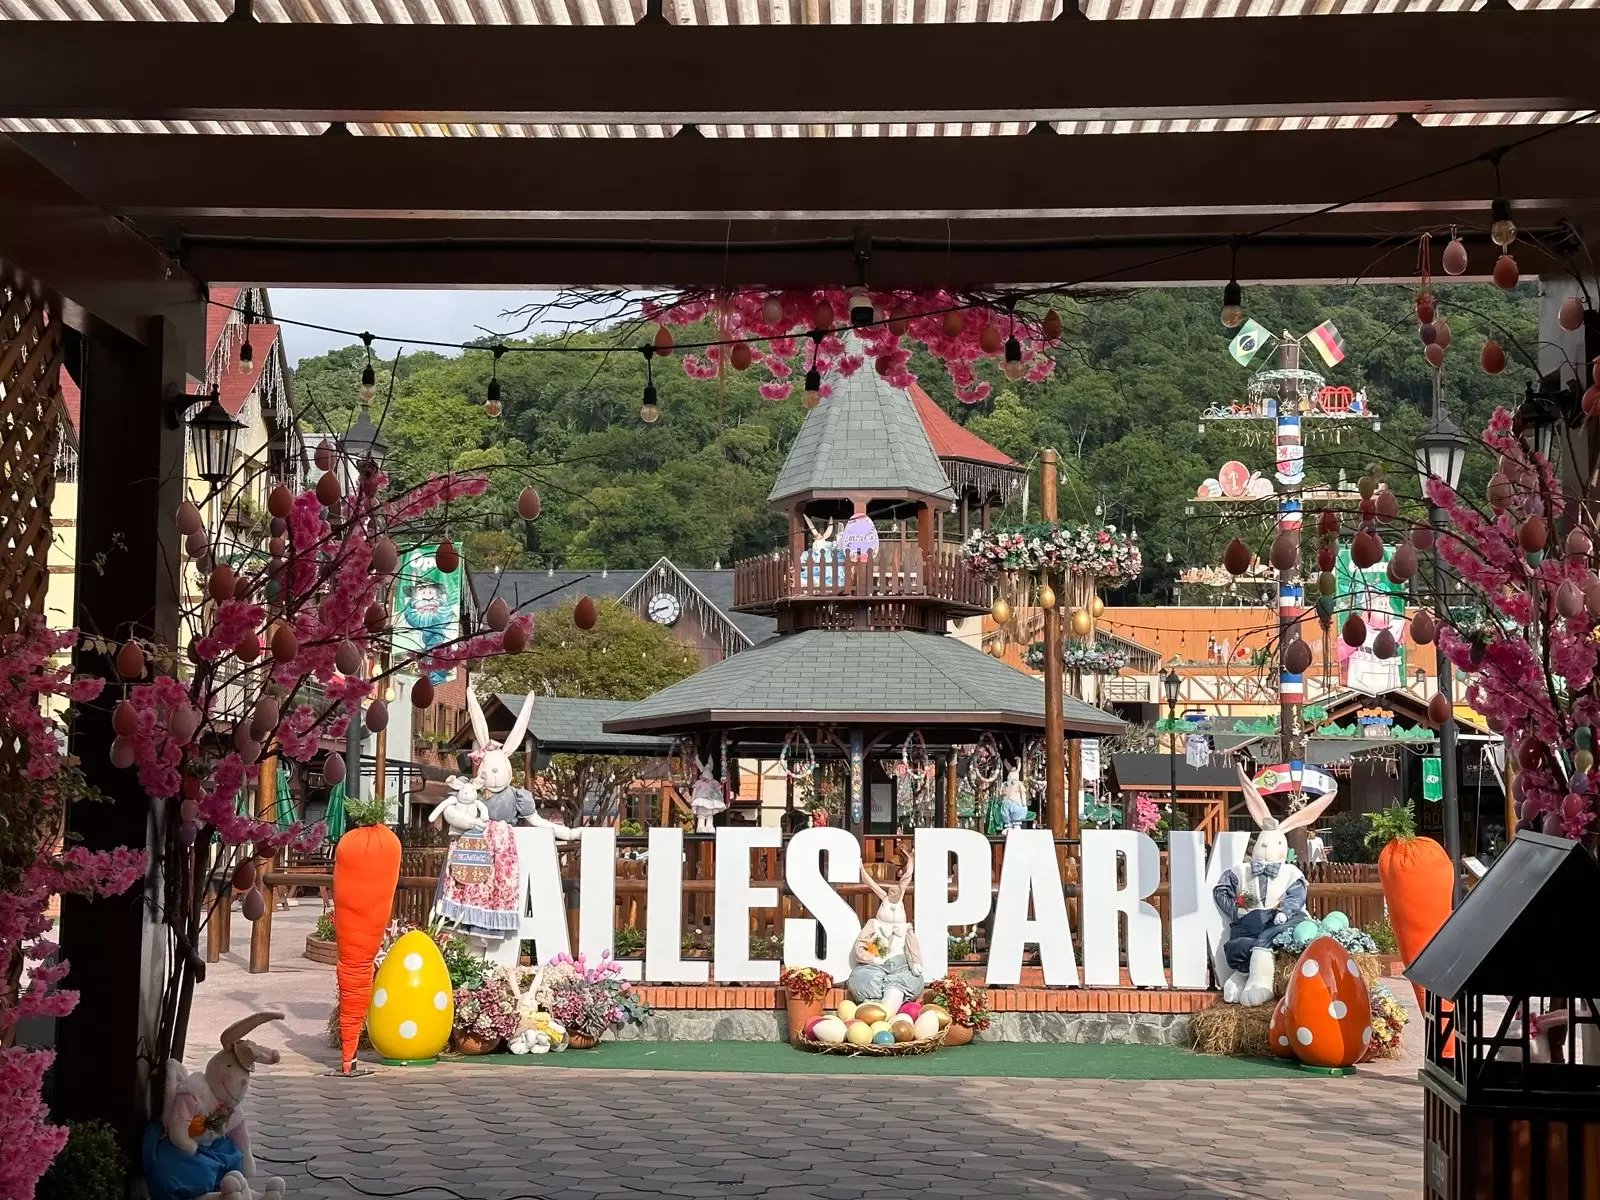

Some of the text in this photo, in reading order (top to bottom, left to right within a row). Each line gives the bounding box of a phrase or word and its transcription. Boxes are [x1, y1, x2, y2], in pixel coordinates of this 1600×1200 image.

[409, 552, 437, 571] Op
[484, 826, 1250, 989] ALLES PARK
